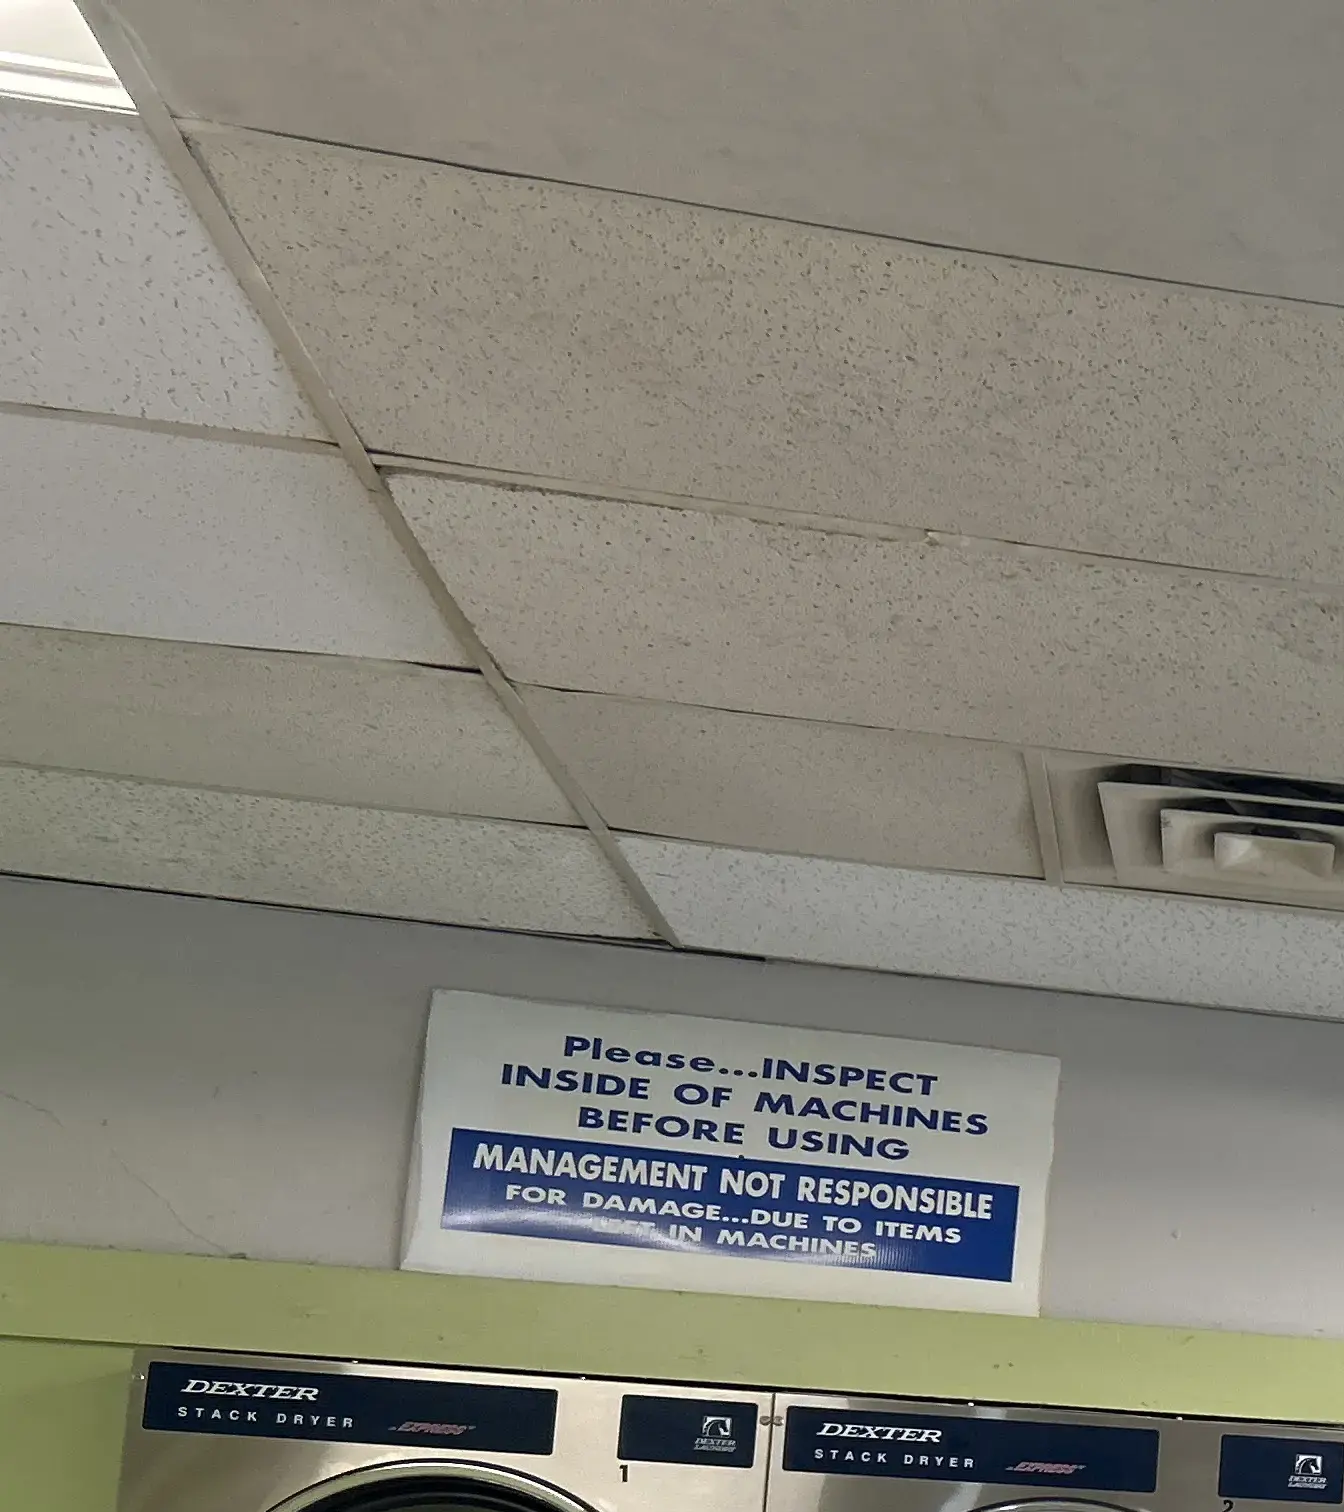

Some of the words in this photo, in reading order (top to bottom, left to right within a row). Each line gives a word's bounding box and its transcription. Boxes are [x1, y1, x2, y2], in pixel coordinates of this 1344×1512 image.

[501, 1063, 651, 1100] INSIDE
[673, 1083, 733, 1108] OF
[753, 1091, 988, 1135] MACHINES
[577, 1106, 745, 1145] BEFORE
[768, 1126, 910, 1161] USING
[472, 1142, 708, 1191] MANAGEMENT
[719, 1168, 786, 1199] NOT
[797, 1175, 993, 1220] RESPONSIBLE
[505, 1184, 567, 1206] FOR
[822, 1215, 862, 1234] TO
[875, 1220, 961, 1244] ITEMS
[668, 1223, 702, 1242] IN
[715, 1228, 878, 1258] MACHINES
[182, 1378, 319, 1401] DEXTER
[178, 1406, 258, 1422] STACK
[277, 1412, 354, 1428] DRYER
[816, 1422, 943, 1444] DEXTER
[618, 1464, 630, 1483] 1
[814, 1448, 888, 1464] STACK
[903, 1454, 975, 1470] DRYER
